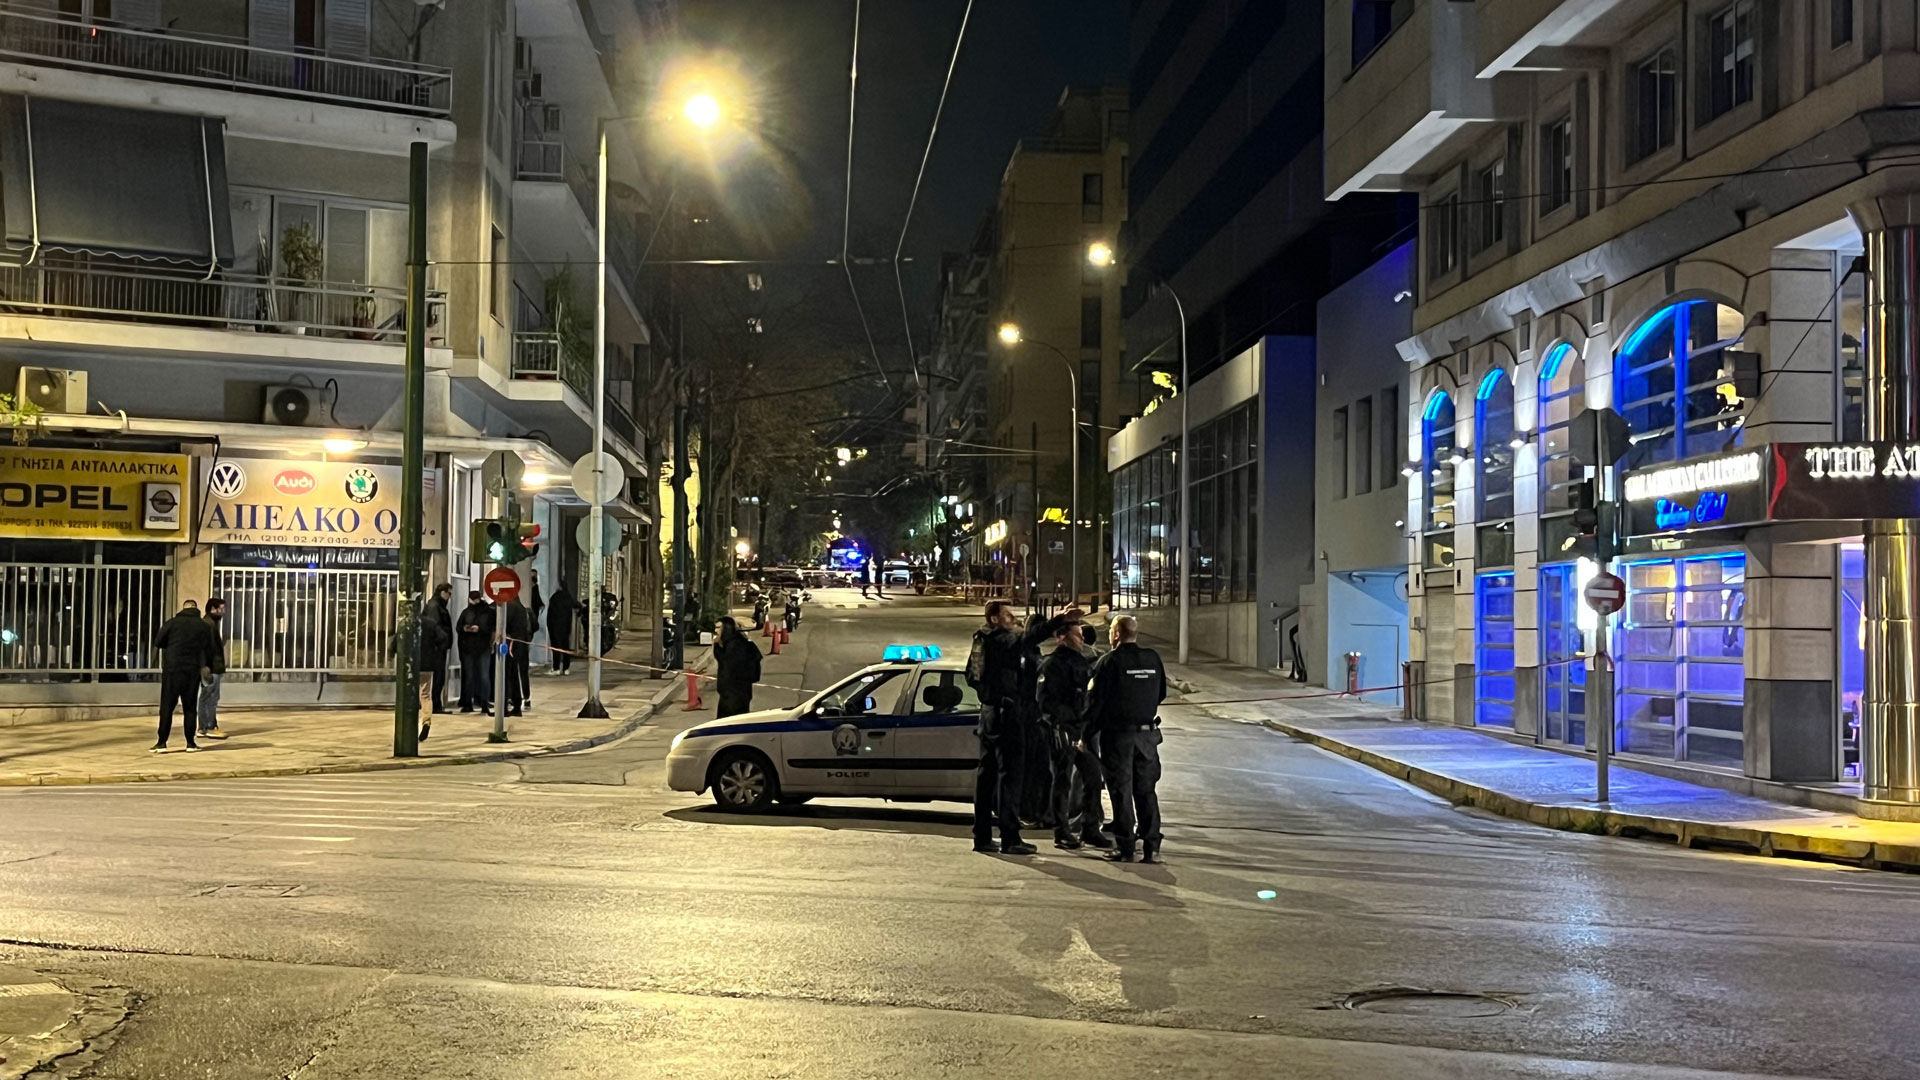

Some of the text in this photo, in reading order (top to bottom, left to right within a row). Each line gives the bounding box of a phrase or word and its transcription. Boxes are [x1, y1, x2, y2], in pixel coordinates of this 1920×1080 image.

[12, 457, 65, 471] ΓΝΗΣΙΑ
[70, 460, 179, 475] ΑΝΤΑΛΛΑΚΤΙΚΑ
[1805, 446, 1875, 478] THE
[276, 476, 313, 488] Audi
[0, 483, 128, 511] OPEL
[206, 503, 360, 533] ΑΠΕΛΚΟ
[261, 535, 288, 543] (210)
